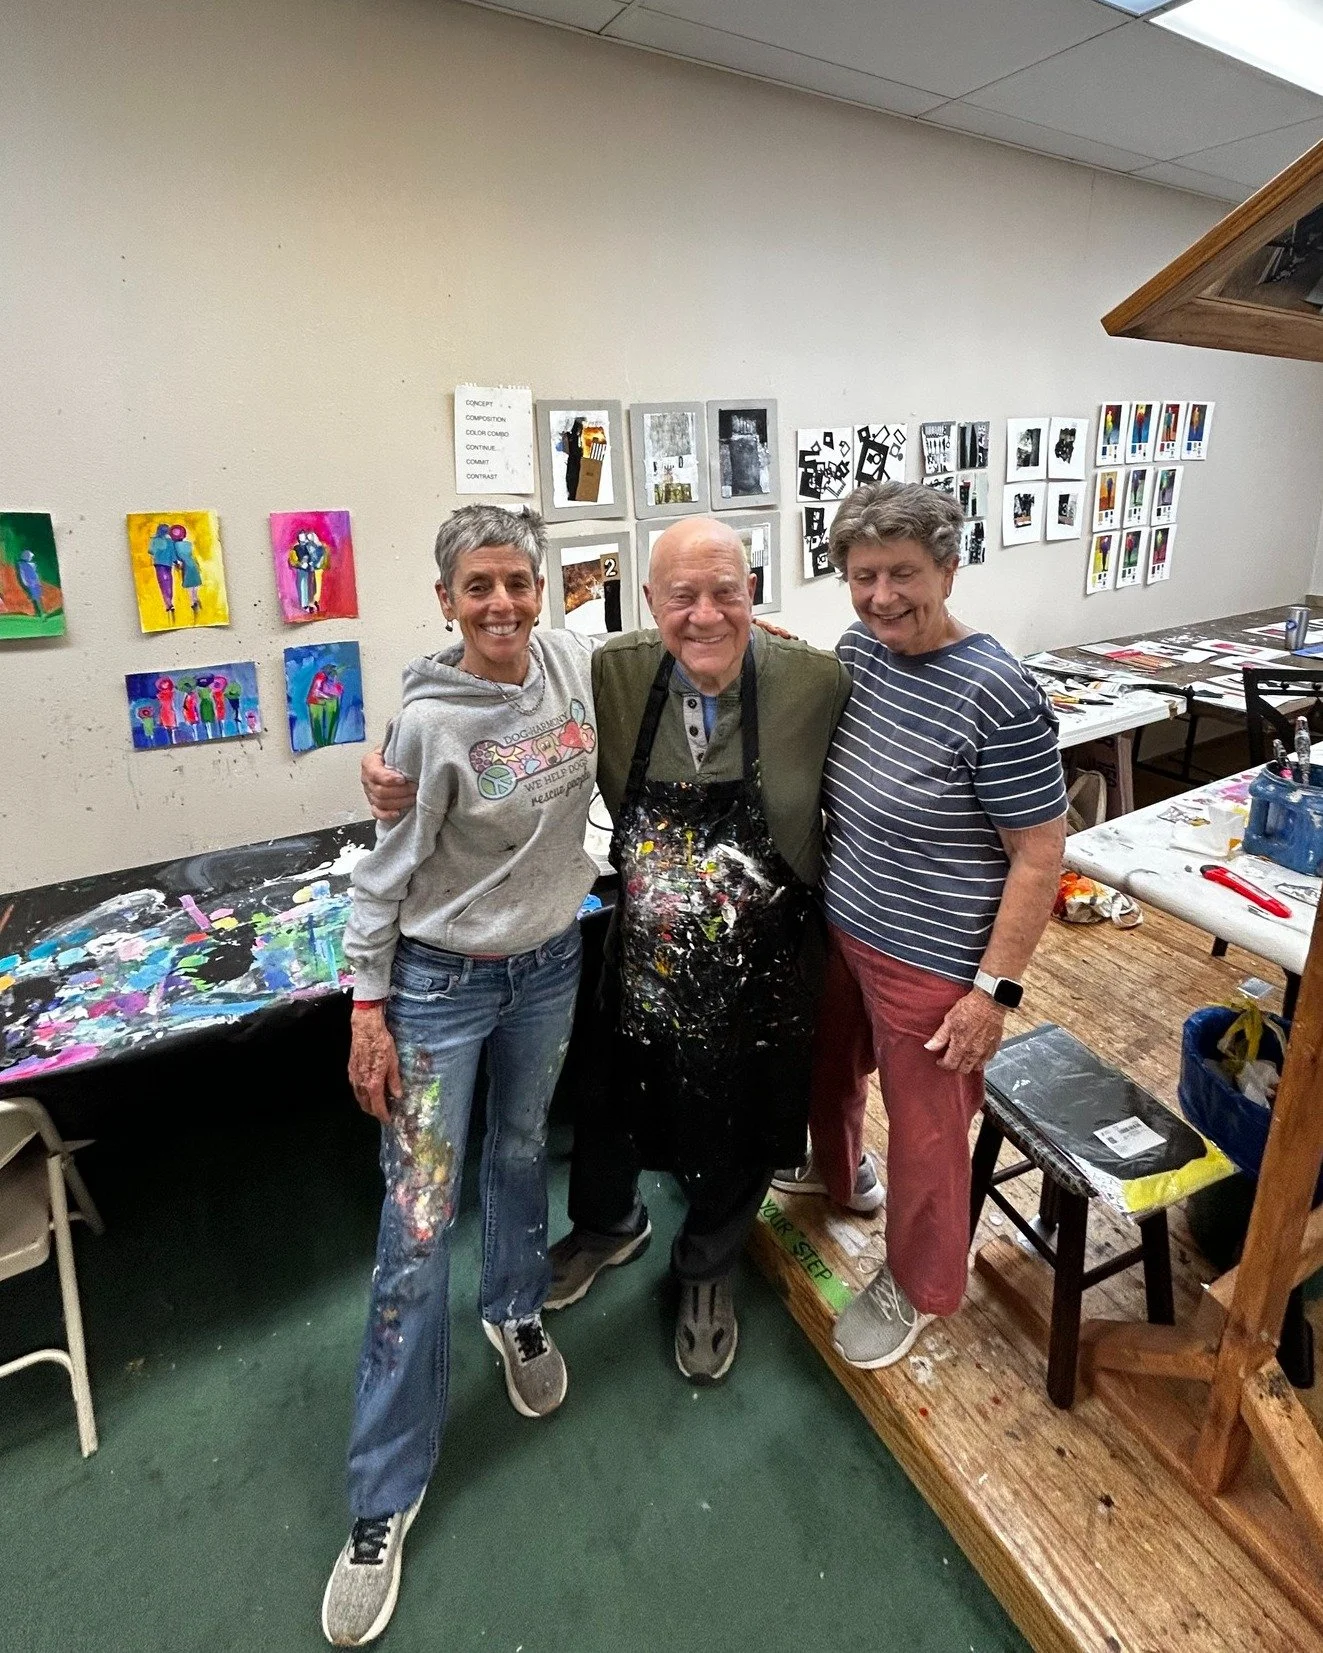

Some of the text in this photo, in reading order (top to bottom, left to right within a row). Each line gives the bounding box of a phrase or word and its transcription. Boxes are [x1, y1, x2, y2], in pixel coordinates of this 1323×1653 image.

[465, 399, 493, 407] CONCEPT
[465, 414, 507, 422] COMPOSITION
[604, 558, 618, 577] 2
[503, 712, 569, 745] DOG HARMONY
[524, 779, 543, 792] WE
[544, 768, 567, 786] HELP
[531, 784, 566, 807] rescue
[760, 1198, 833, 1280] YOUR STEP
